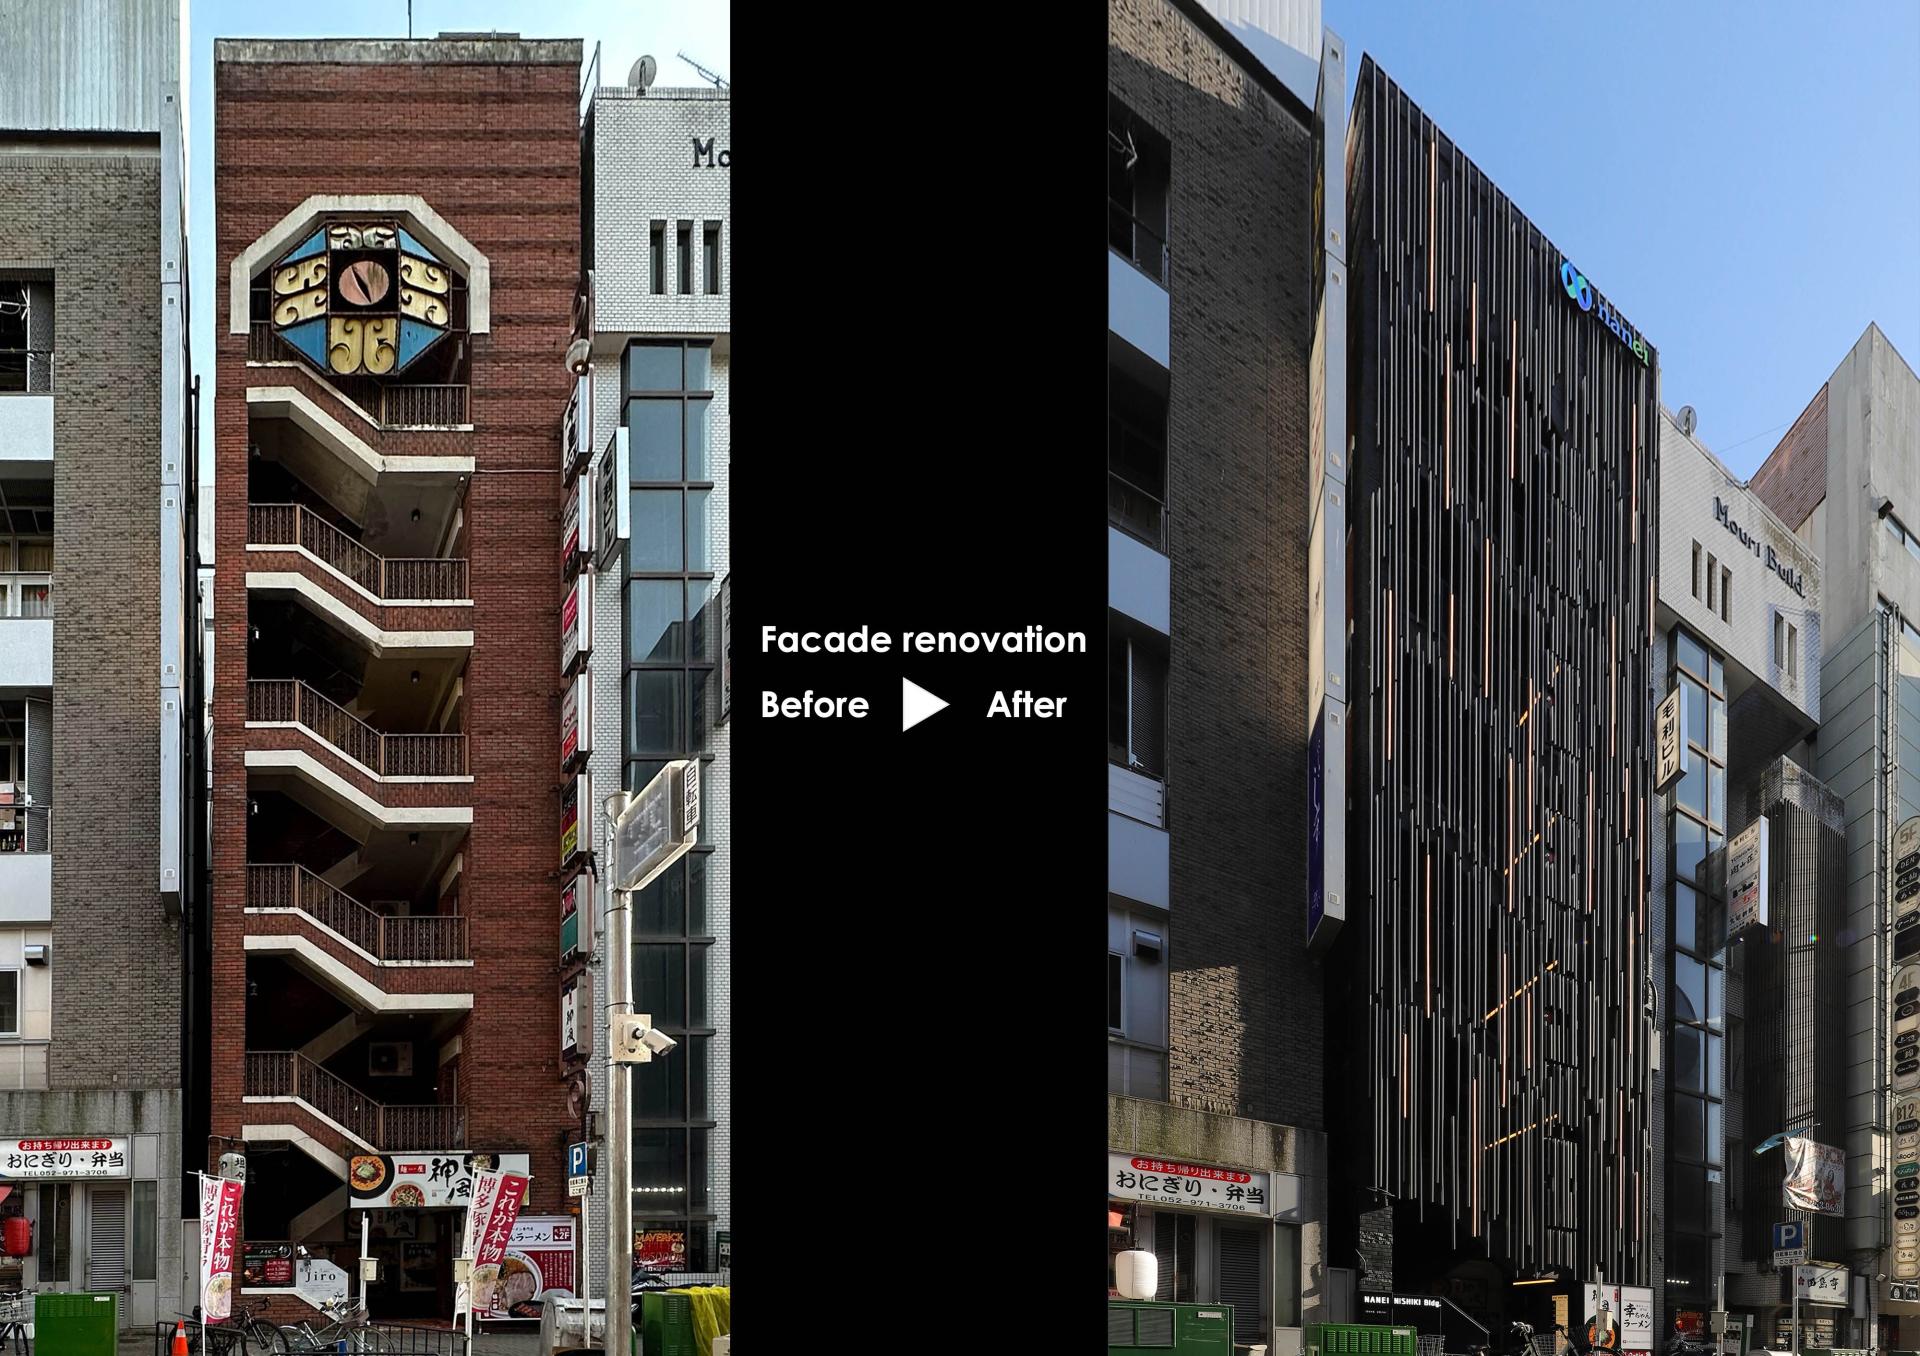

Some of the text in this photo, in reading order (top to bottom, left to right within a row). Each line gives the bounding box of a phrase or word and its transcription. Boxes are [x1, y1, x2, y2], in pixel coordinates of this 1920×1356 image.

[1714, 496, 1760, 558] Mouri
[1661, 697, 1674, 780] 毛利ビル
[686, 765, 698, 825] 自転車
[22, 1141, 109, 1150] お持ち帰り出来ます
[7, 1152, 124, 1168] おにぎり・弁当
[573, 1147, 583, 1174] P
[1137, 1160, 1248, 1183] お持ち帰り出来ます
[1116, 1170, 1264, 1205] おにぎり・弁当
[214, 1188, 236, 1271] これが本物
[481, 1181, 519, 1262] これが本物
[559, 1231, 570, 1239] 2F
[635, 1232, 685, 1242] MAVERICK
[1781, 1225, 1797, 1247] P
[1364, 1296, 1441, 1308] NANEI NISHIKI Bldg.
[1624, 1320, 1651, 1328] ラーメン
